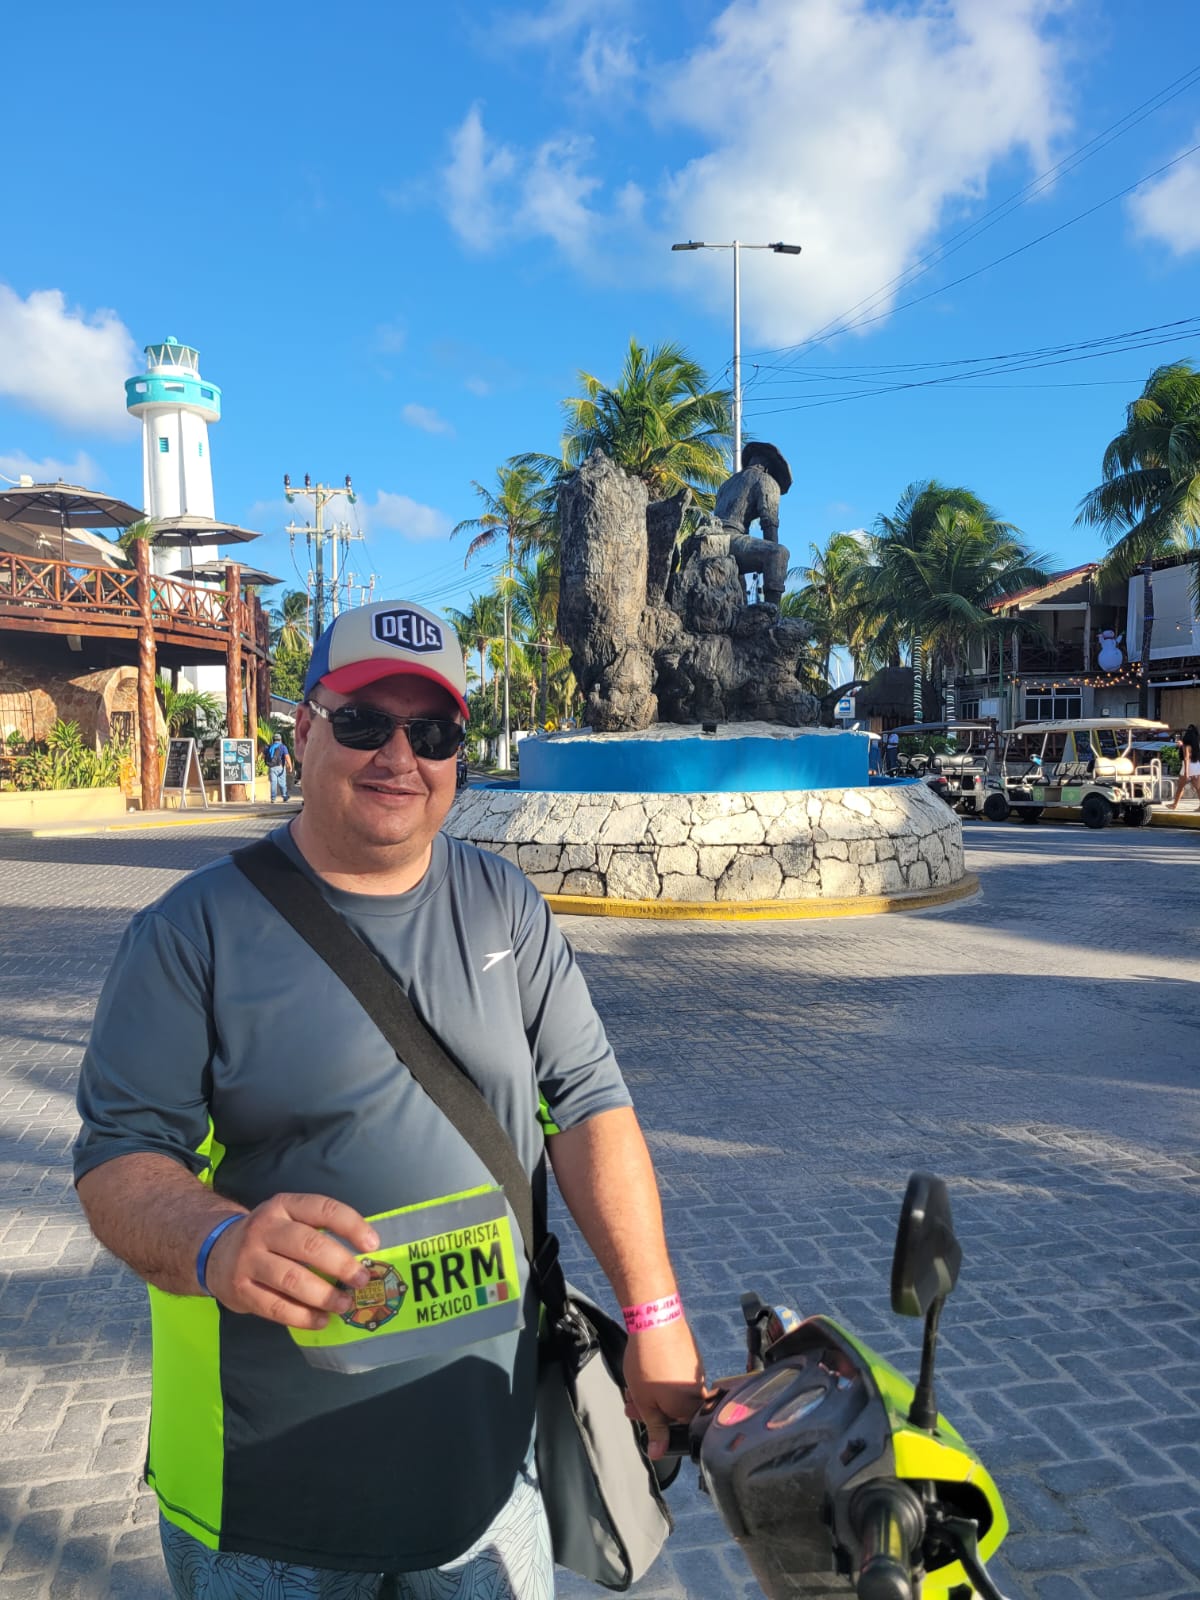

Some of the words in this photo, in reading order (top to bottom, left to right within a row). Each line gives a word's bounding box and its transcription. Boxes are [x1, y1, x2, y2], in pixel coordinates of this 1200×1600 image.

[408, 1222, 500, 1261] MOTOTURISTA
[410, 1241, 506, 1303] RRM
[416, 1294, 473, 1324] MÉXICO
